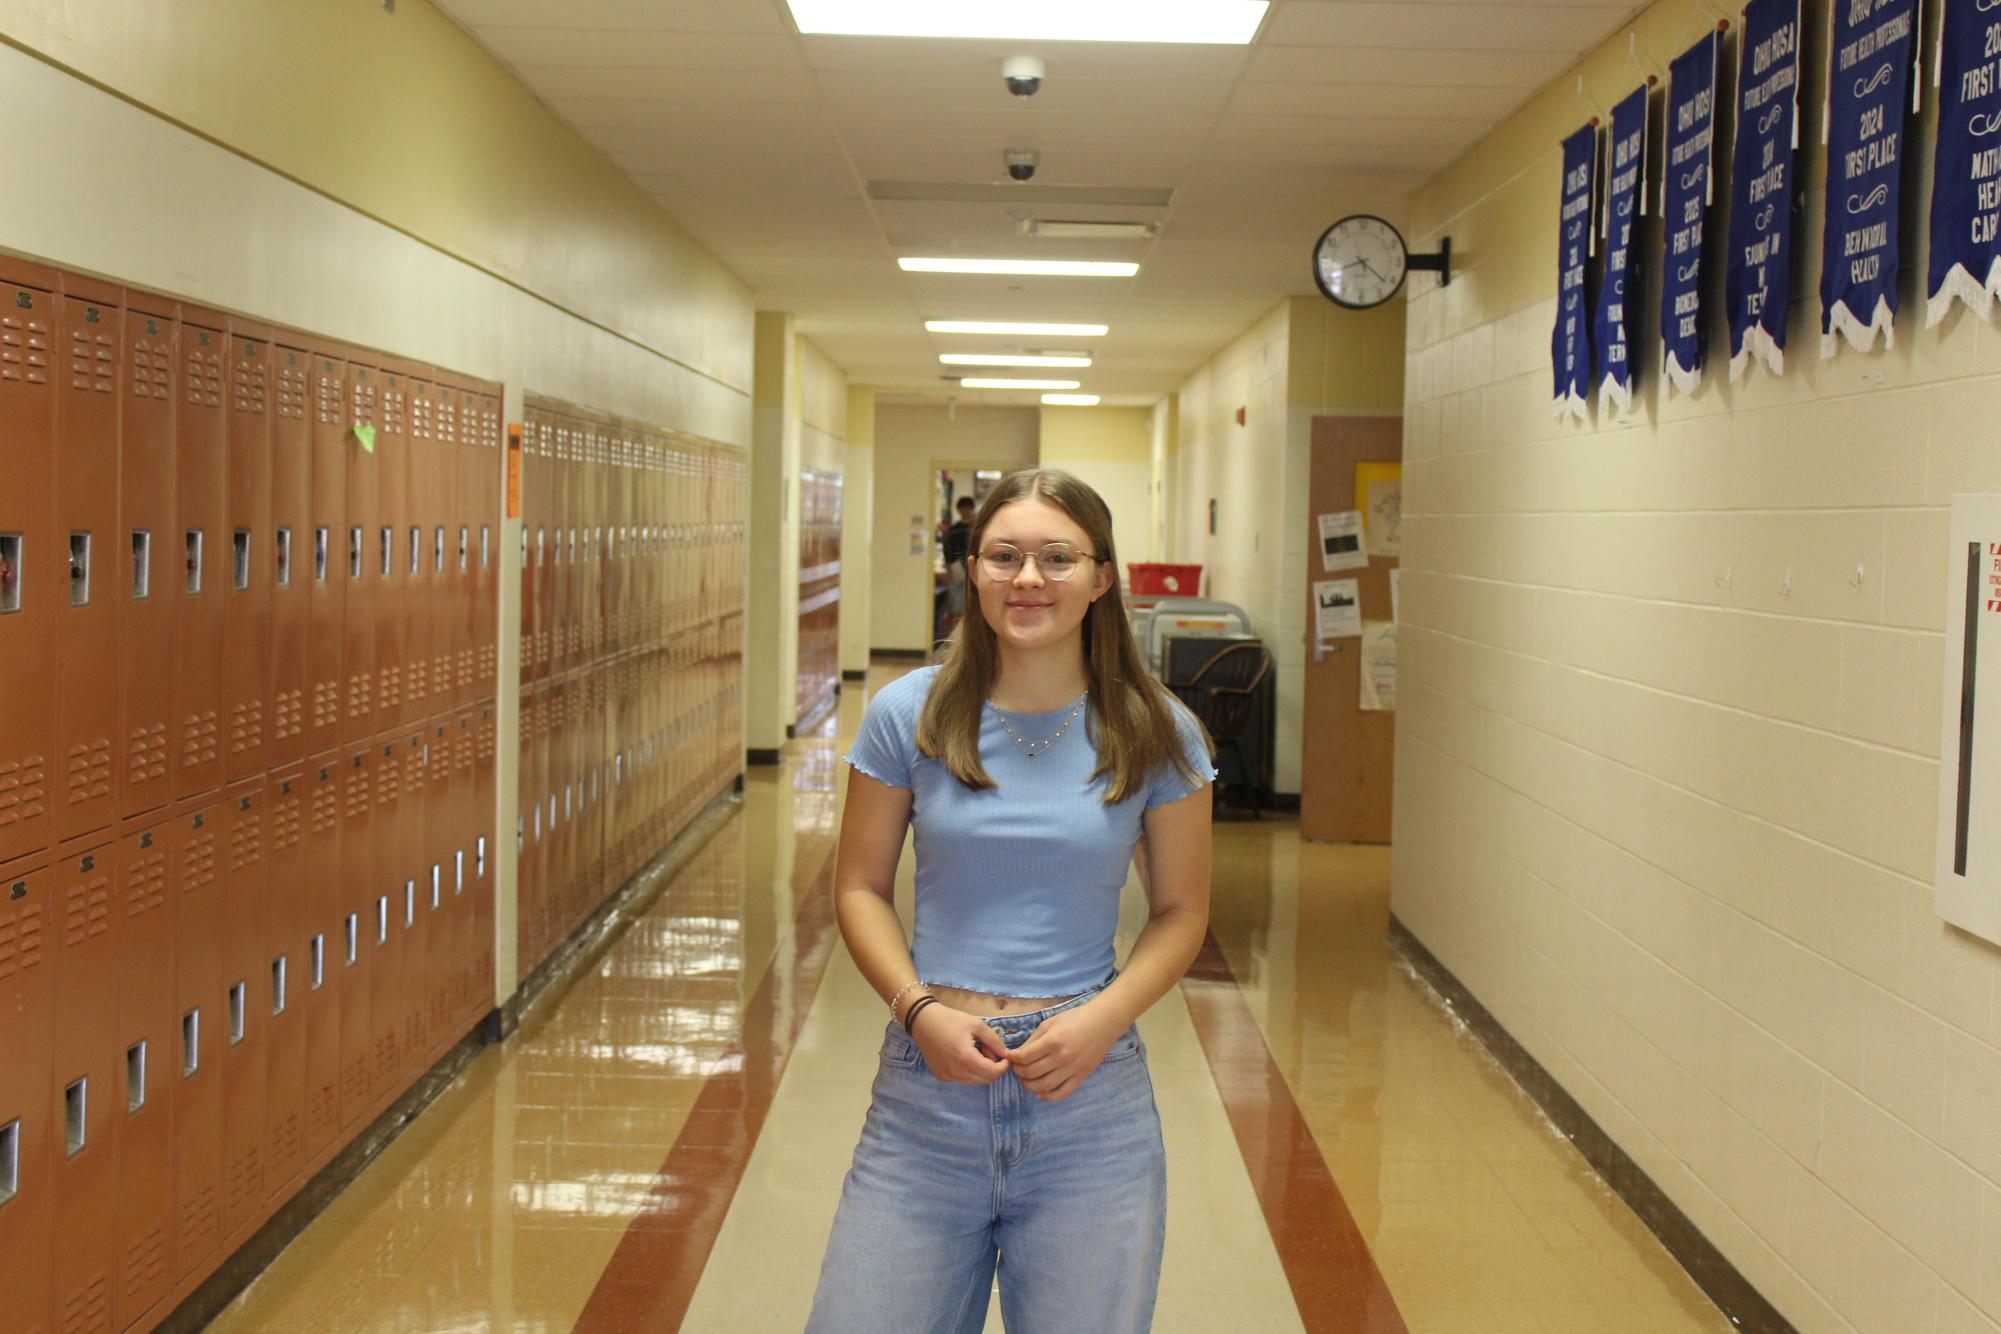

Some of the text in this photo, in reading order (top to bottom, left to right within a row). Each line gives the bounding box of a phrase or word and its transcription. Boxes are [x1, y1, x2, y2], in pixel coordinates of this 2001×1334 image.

[1961, 62, 1996, 104] FIRST
[1860, 104, 1884, 141] 2024
[1868, 132, 1898, 172] PLACE
